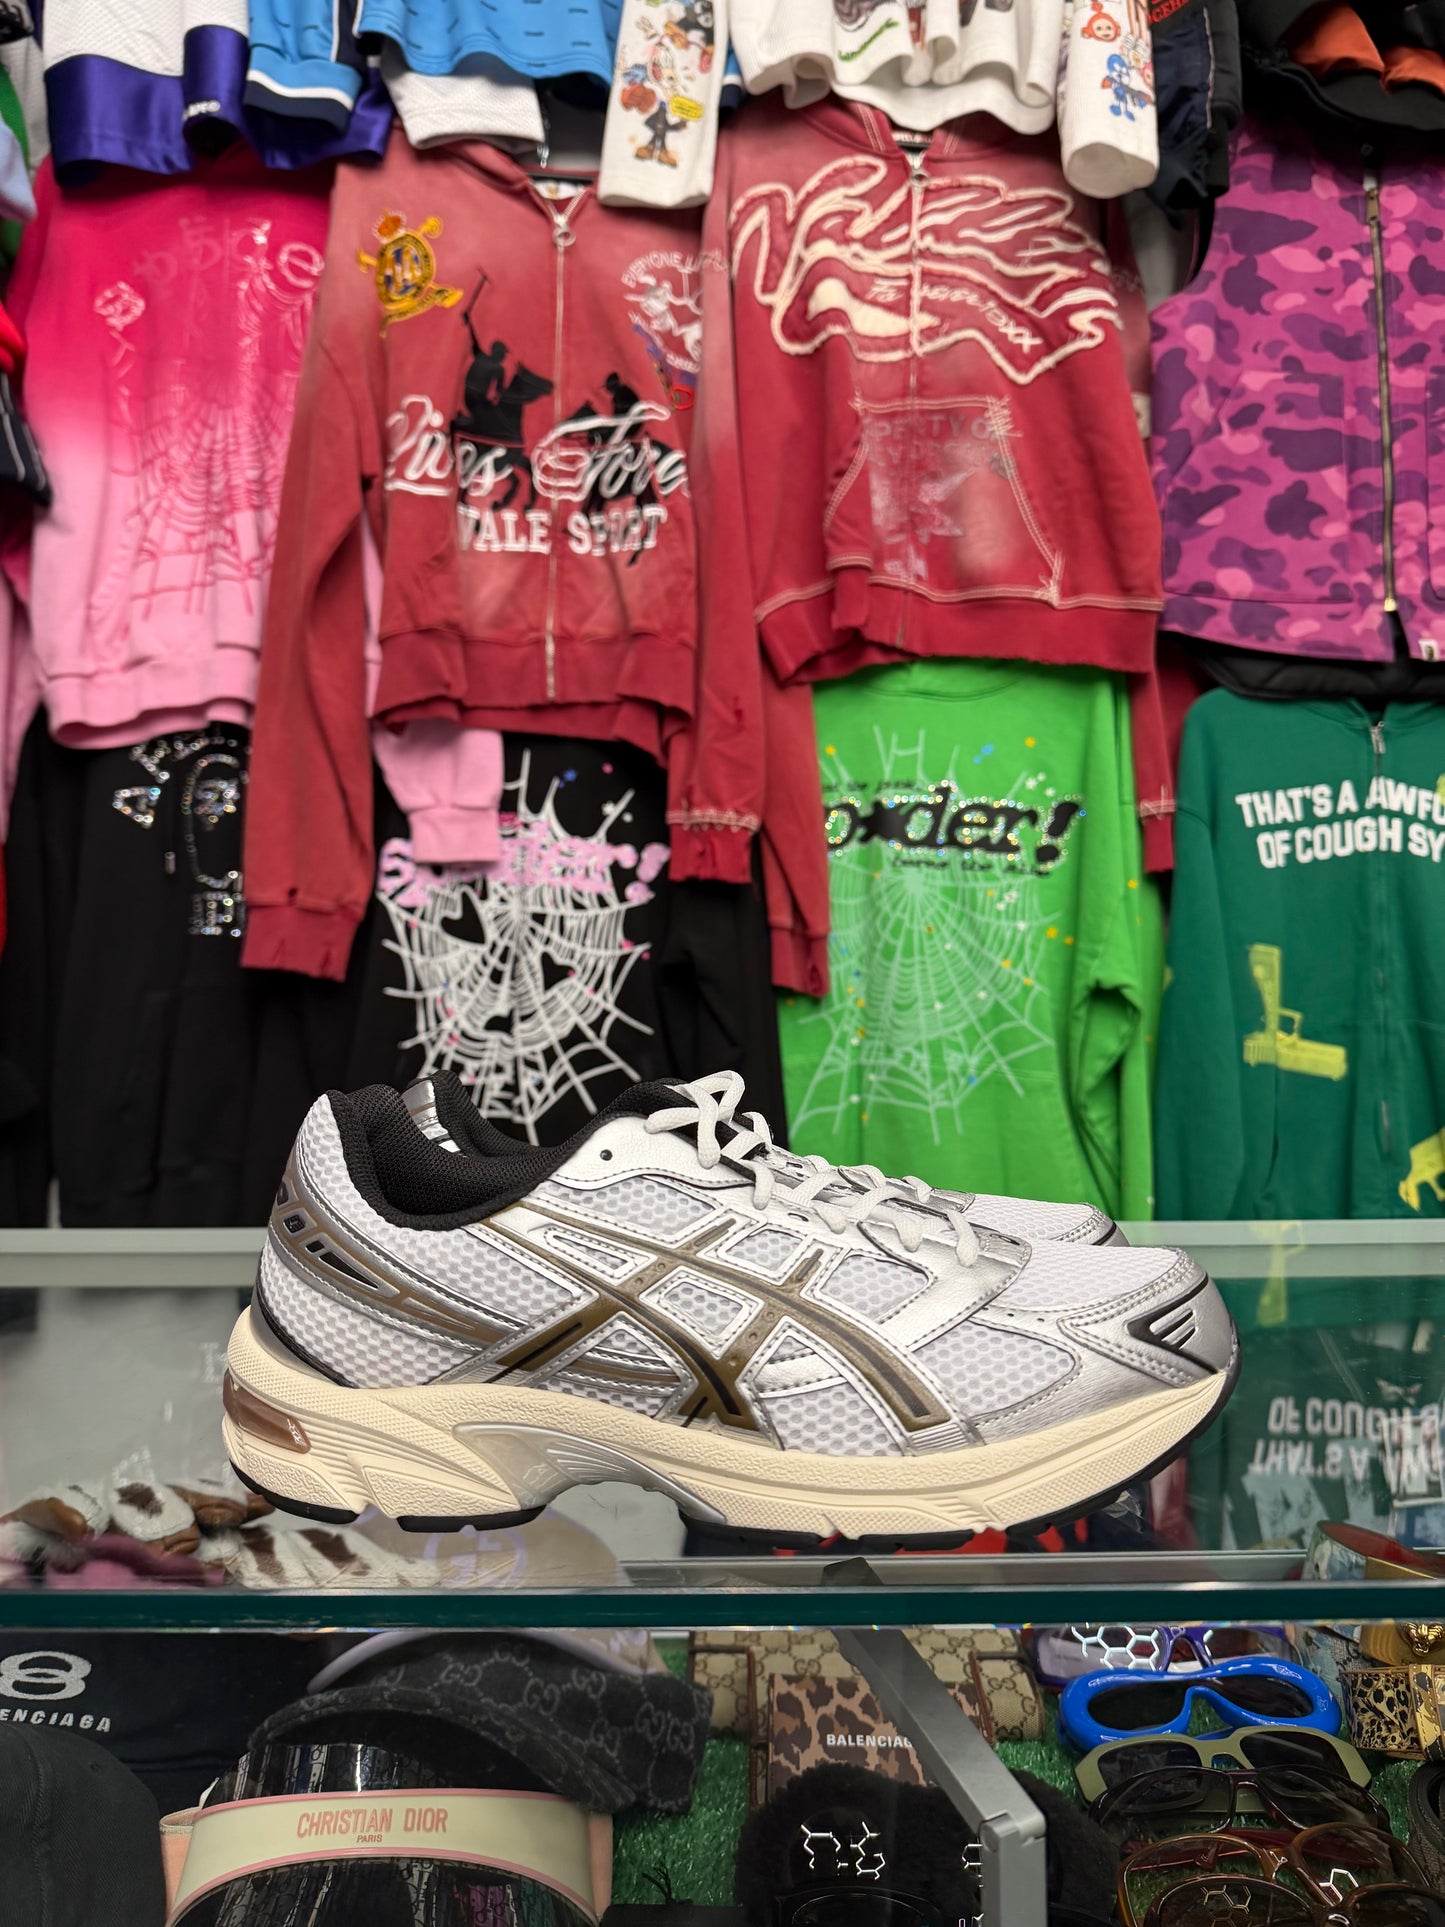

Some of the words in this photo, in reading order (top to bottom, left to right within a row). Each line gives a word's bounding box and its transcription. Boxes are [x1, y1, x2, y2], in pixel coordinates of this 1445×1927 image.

[457, 504, 552, 555] VALE
[1234, 783, 1333, 829] THAT'S
[1336, 779, 1359, 815] A
[1256, 830, 1291, 869] OF
[1294, 814, 1403, 864] COUGH
[297, 1808, 394, 1839] CHRISTIAN
[403, 1807, 449, 1834] DIOR
[356, 1834, 383, 1845] PARIS
